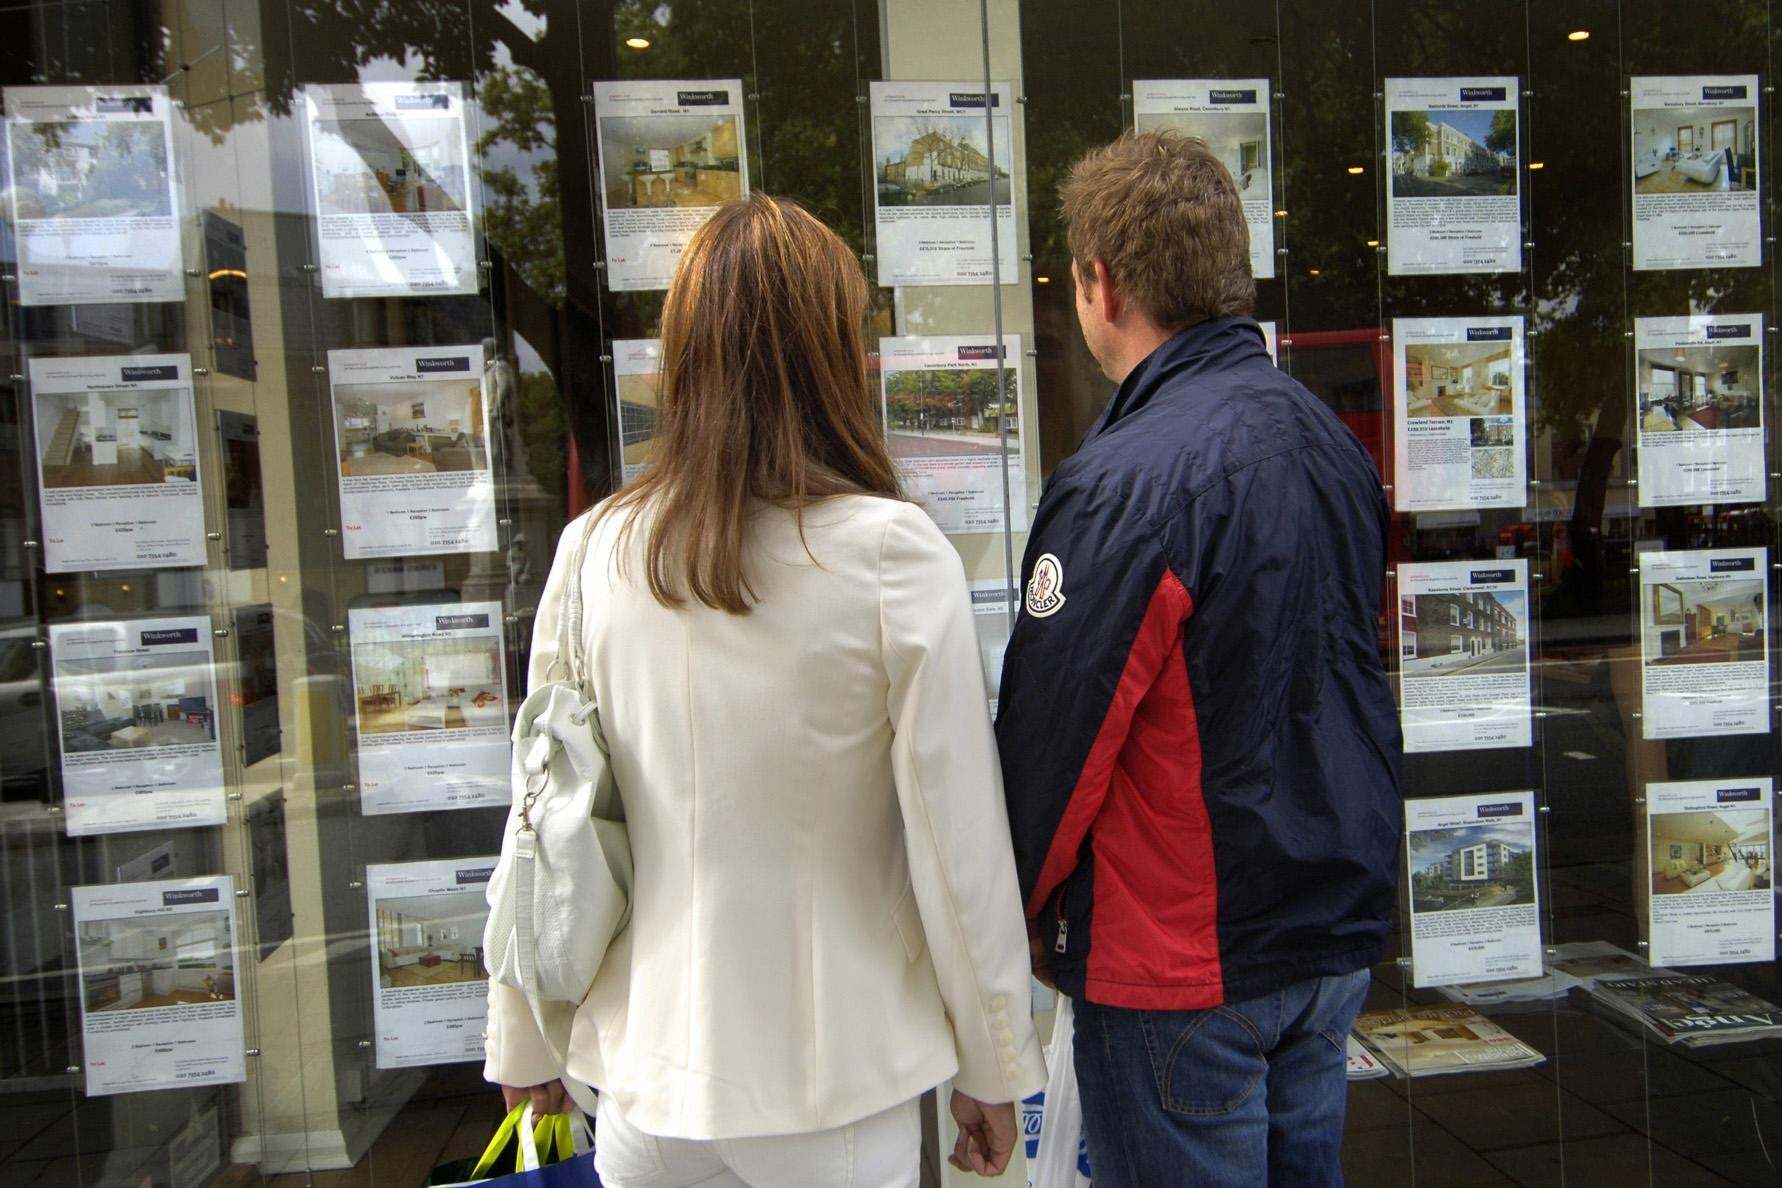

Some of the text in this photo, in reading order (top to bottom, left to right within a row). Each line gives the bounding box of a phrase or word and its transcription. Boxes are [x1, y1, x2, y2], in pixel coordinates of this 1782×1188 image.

[1211, 91, 1243, 99] Winkworth
[1462, 88, 1493, 97] Winkworth
[1704, 87, 1733, 95] Winkworth
[679, 91, 714, 100] Winkworth
[951, 94, 985, 102] Winkworth
[1468, 328, 1499, 336] Winkworth
[960, 347, 994, 355] Winkworth
[418, 359, 455, 367] Winkworth
[123, 368, 162, 376] Winkworth
[1711, 559, 1741, 567] Winkworth
[1472, 570, 1502, 579] Winkworth
[1030, 582, 1055, 609] MONCLER
[143, 631, 181, 639] Winkworth
[1718, 789, 1748, 798] Winkworth
[1479, 805, 1509, 814] Winkworth
[165, 891, 202, 899] Winkworth
